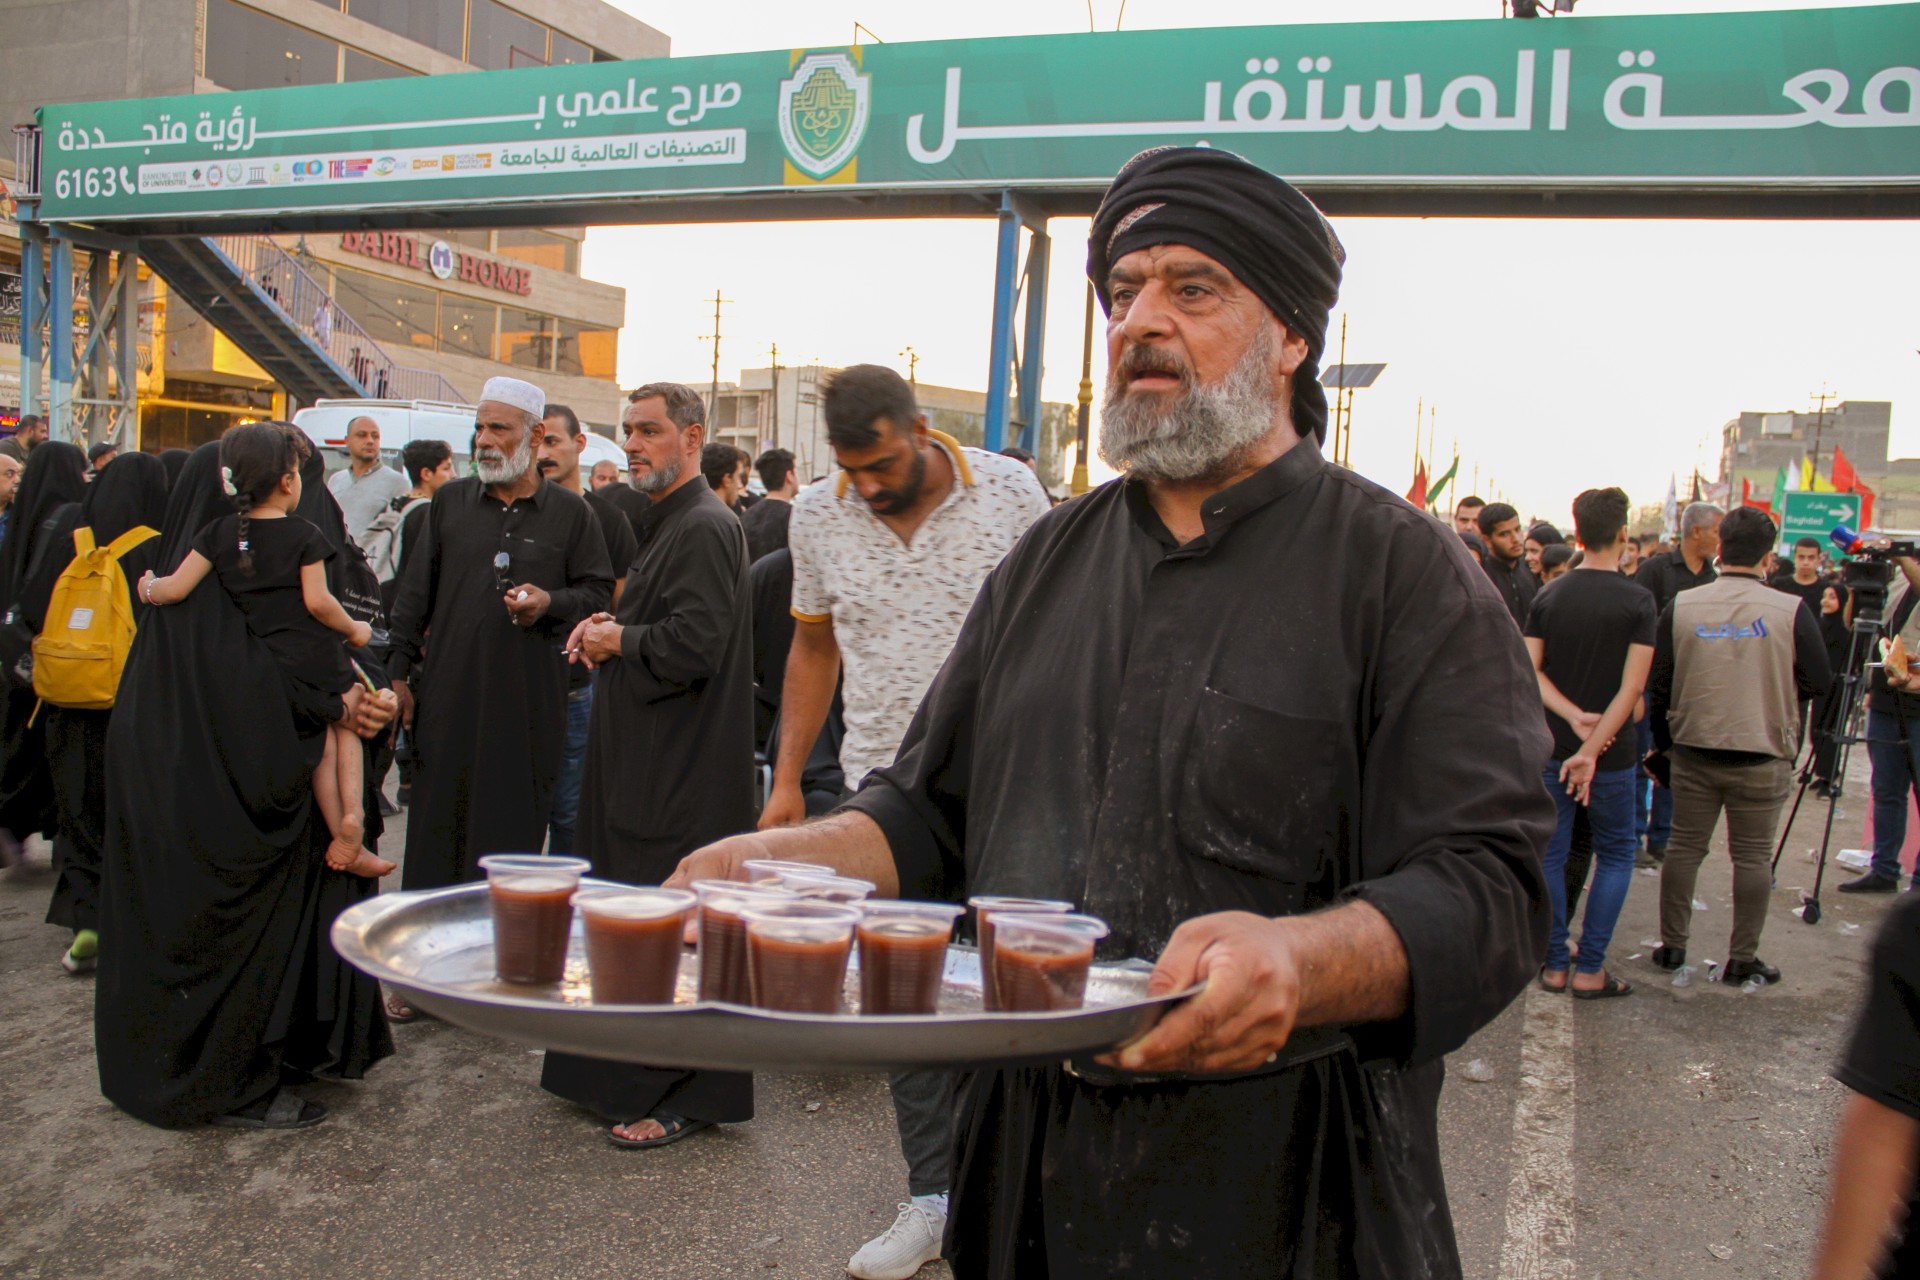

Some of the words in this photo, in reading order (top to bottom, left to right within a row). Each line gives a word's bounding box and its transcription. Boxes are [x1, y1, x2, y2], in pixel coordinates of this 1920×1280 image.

[556, 78, 659, 128] علمي
[667, 81, 741, 126] صرح
[500, 146, 565, 169] للجامعة
[571, 142, 638, 167] العالمية
[644, 136, 735, 162] التصنيفات
[56, 167, 116, 198] 6163
[328, 160, 345, 179] THE
[142, 179, 149, 188] OF
[150, 178, 187, 188] UNIVERSITIES
[459, 252, 532, 297] HOME
[1785, 515, 1824, 526] Baghdad
[1695, 616, 1768, 642] العراقية
